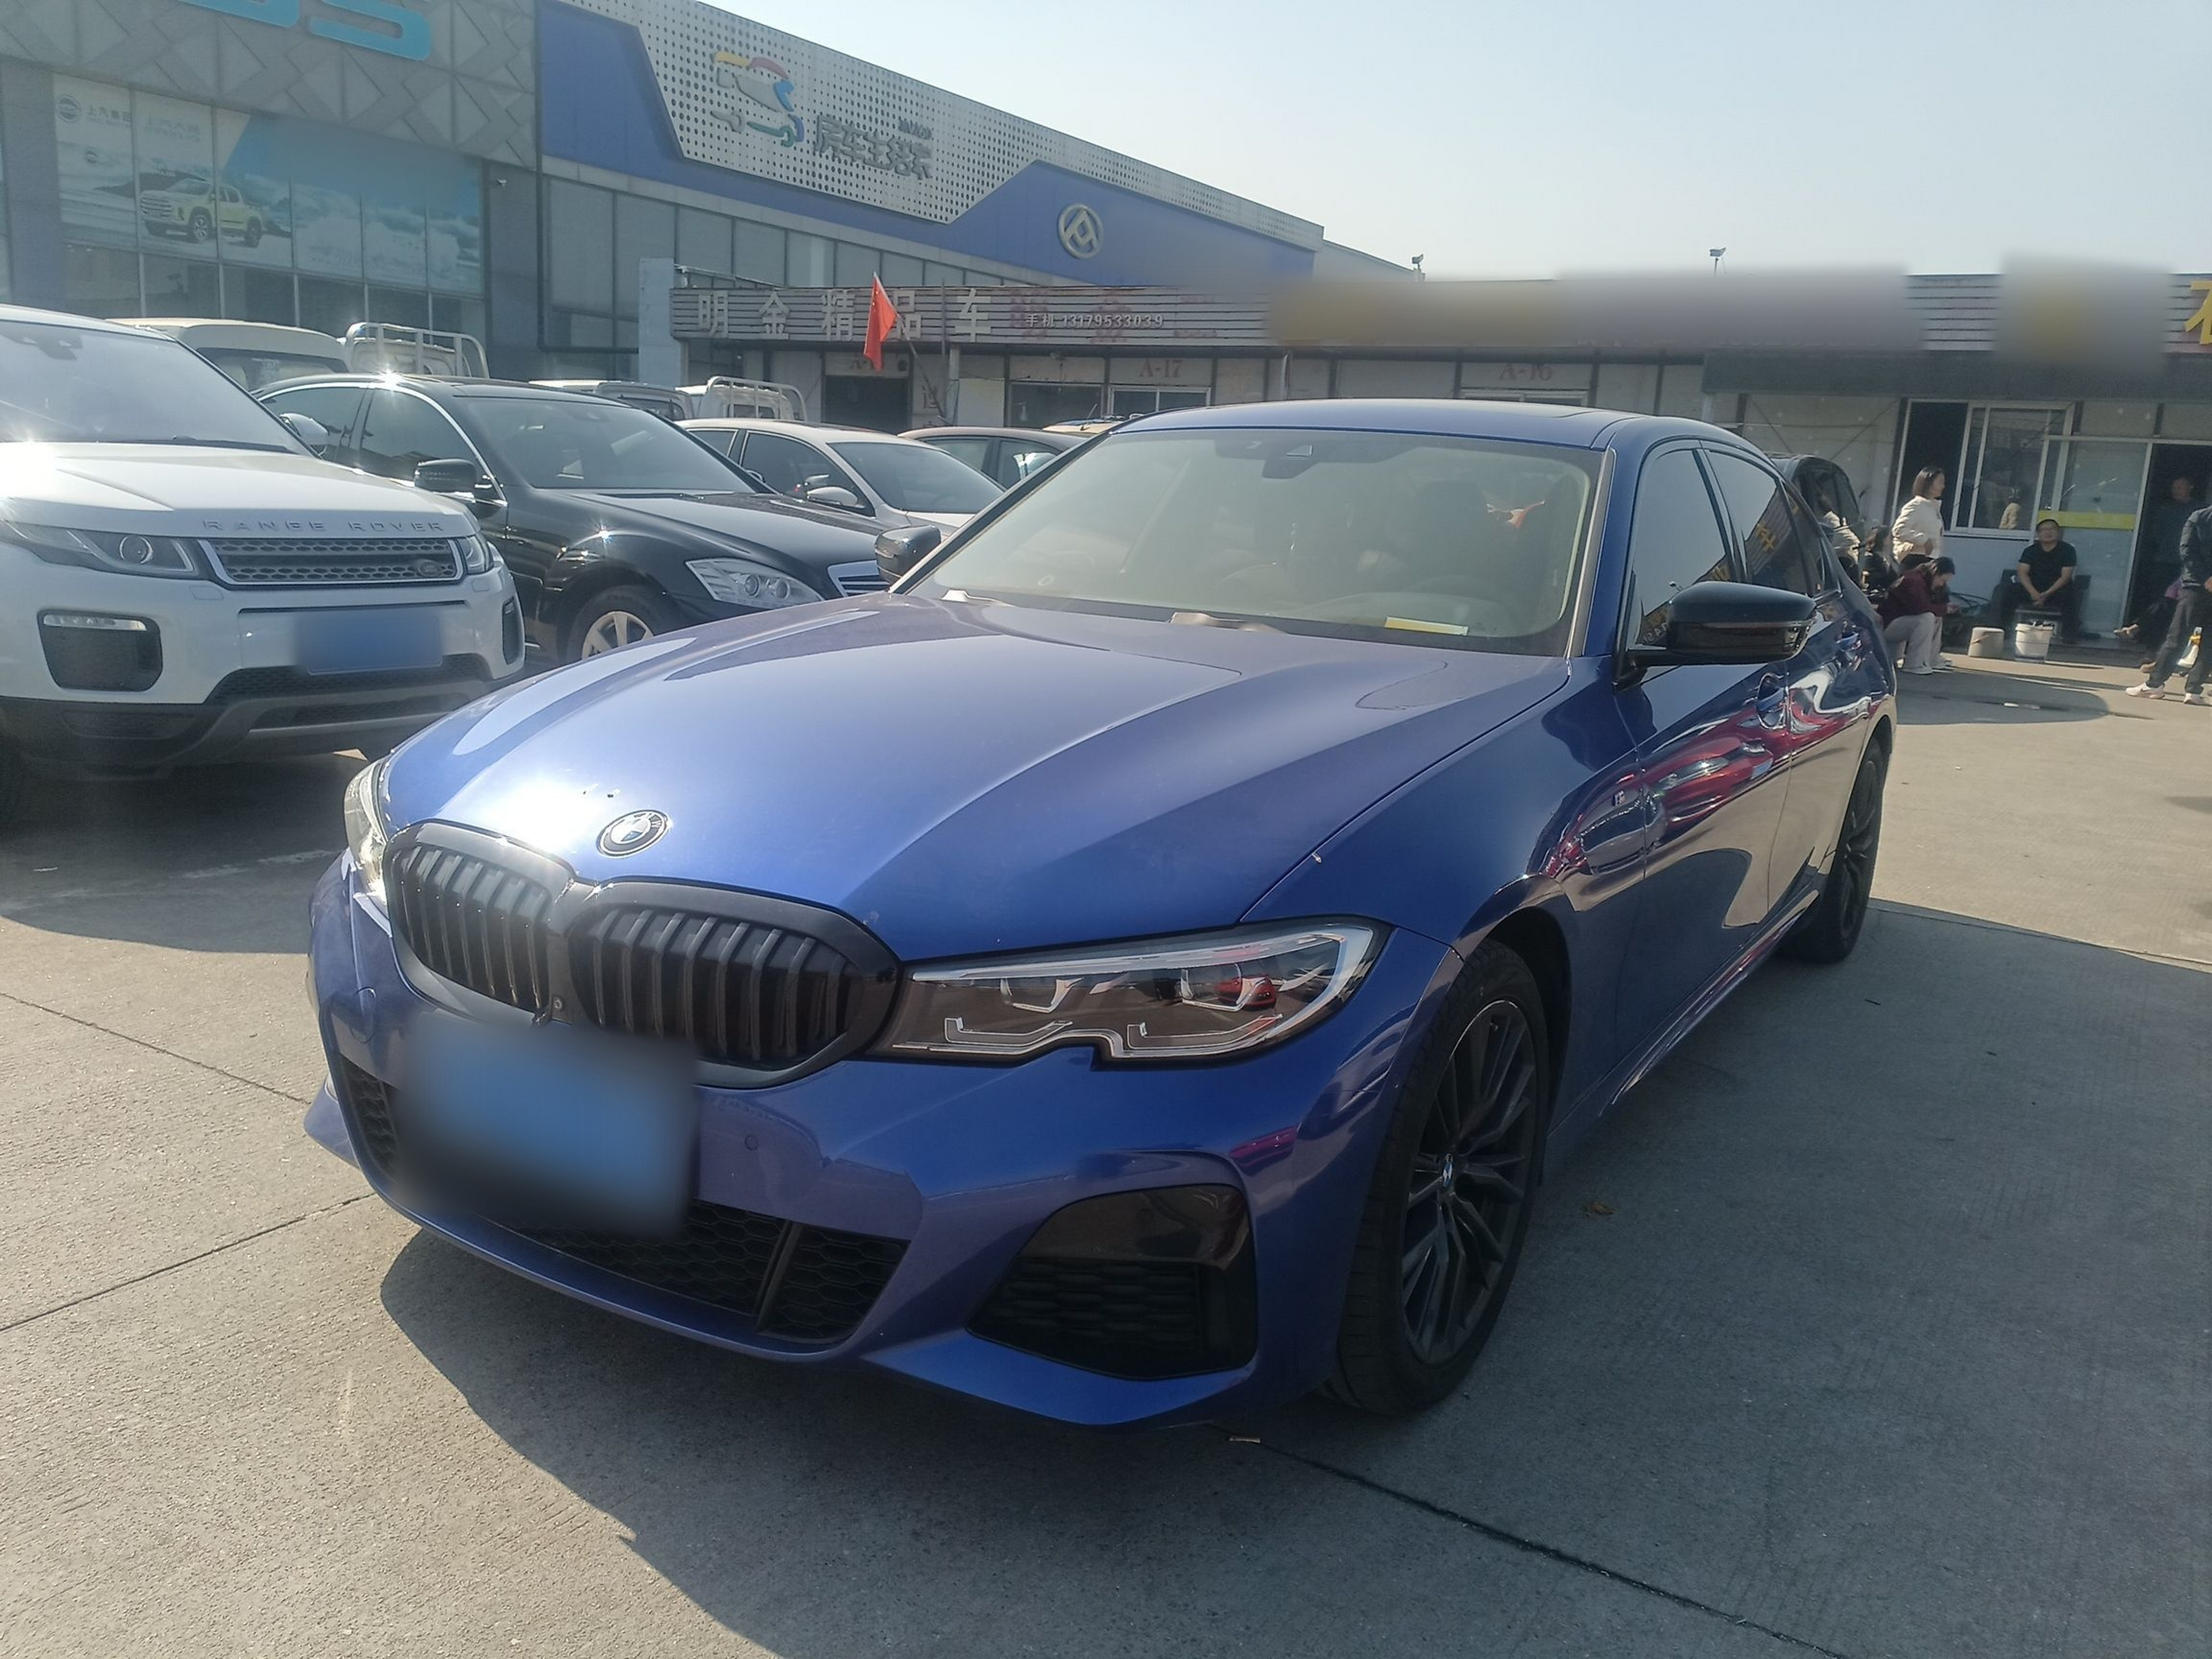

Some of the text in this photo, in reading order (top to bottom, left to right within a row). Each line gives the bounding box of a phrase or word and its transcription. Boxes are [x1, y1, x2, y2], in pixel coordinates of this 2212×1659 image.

[1026, 313, 1164, 328] 手机 13179533039
[1140, 358, 1183, 378] A-17
[203, 520, 444, 532] RANGE ROVER
